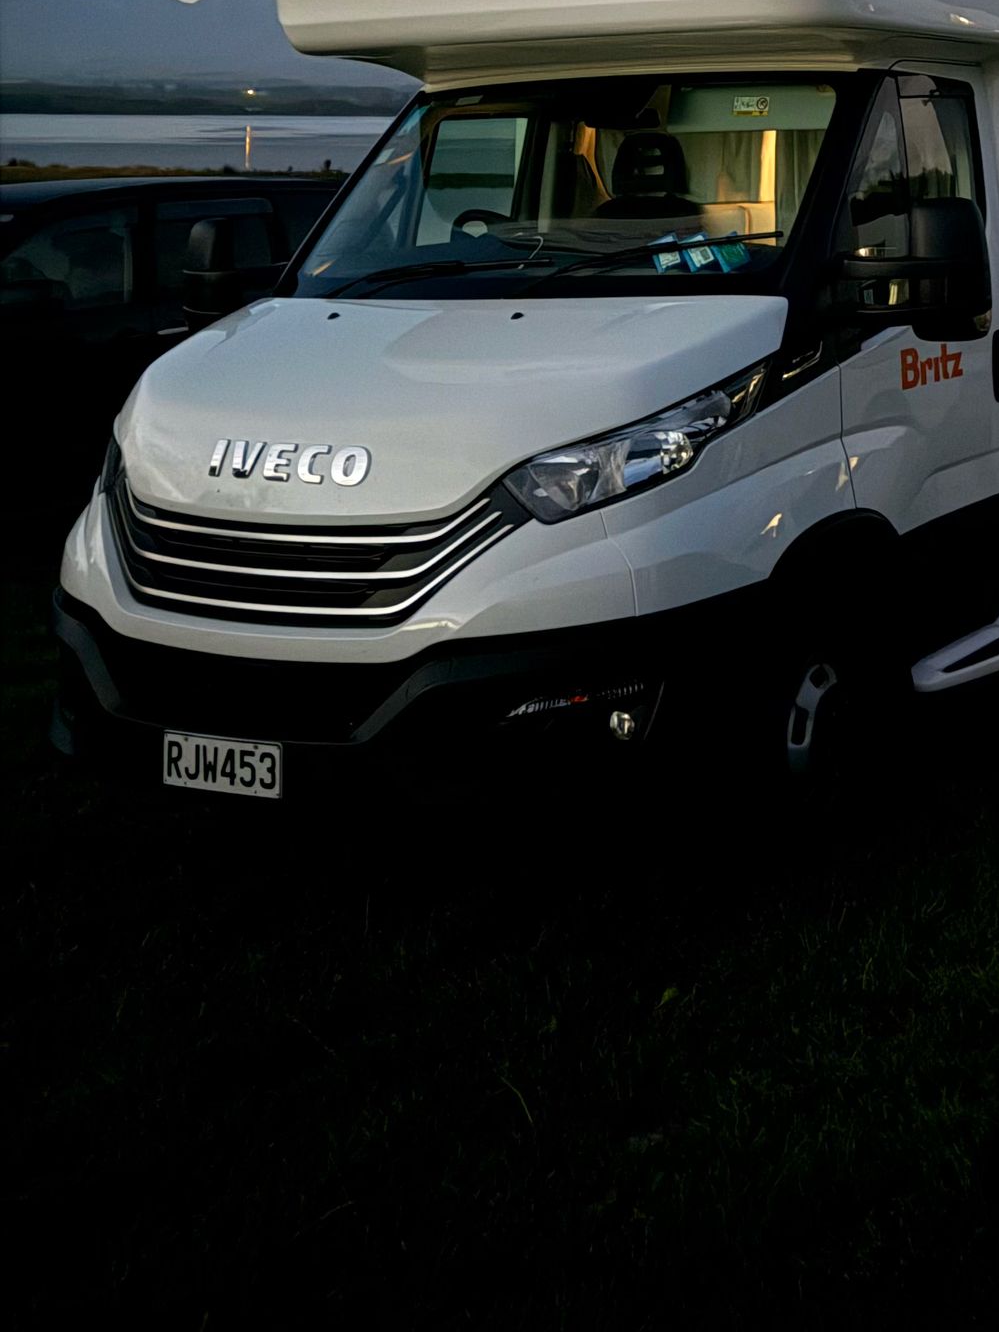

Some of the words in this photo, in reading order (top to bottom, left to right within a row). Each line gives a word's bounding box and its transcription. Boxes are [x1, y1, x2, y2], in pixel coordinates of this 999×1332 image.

[901, 344, 963, 390] Britz
[208, 439, 372, 487] IVECO
[167, 741, 276, 789] RJW453
